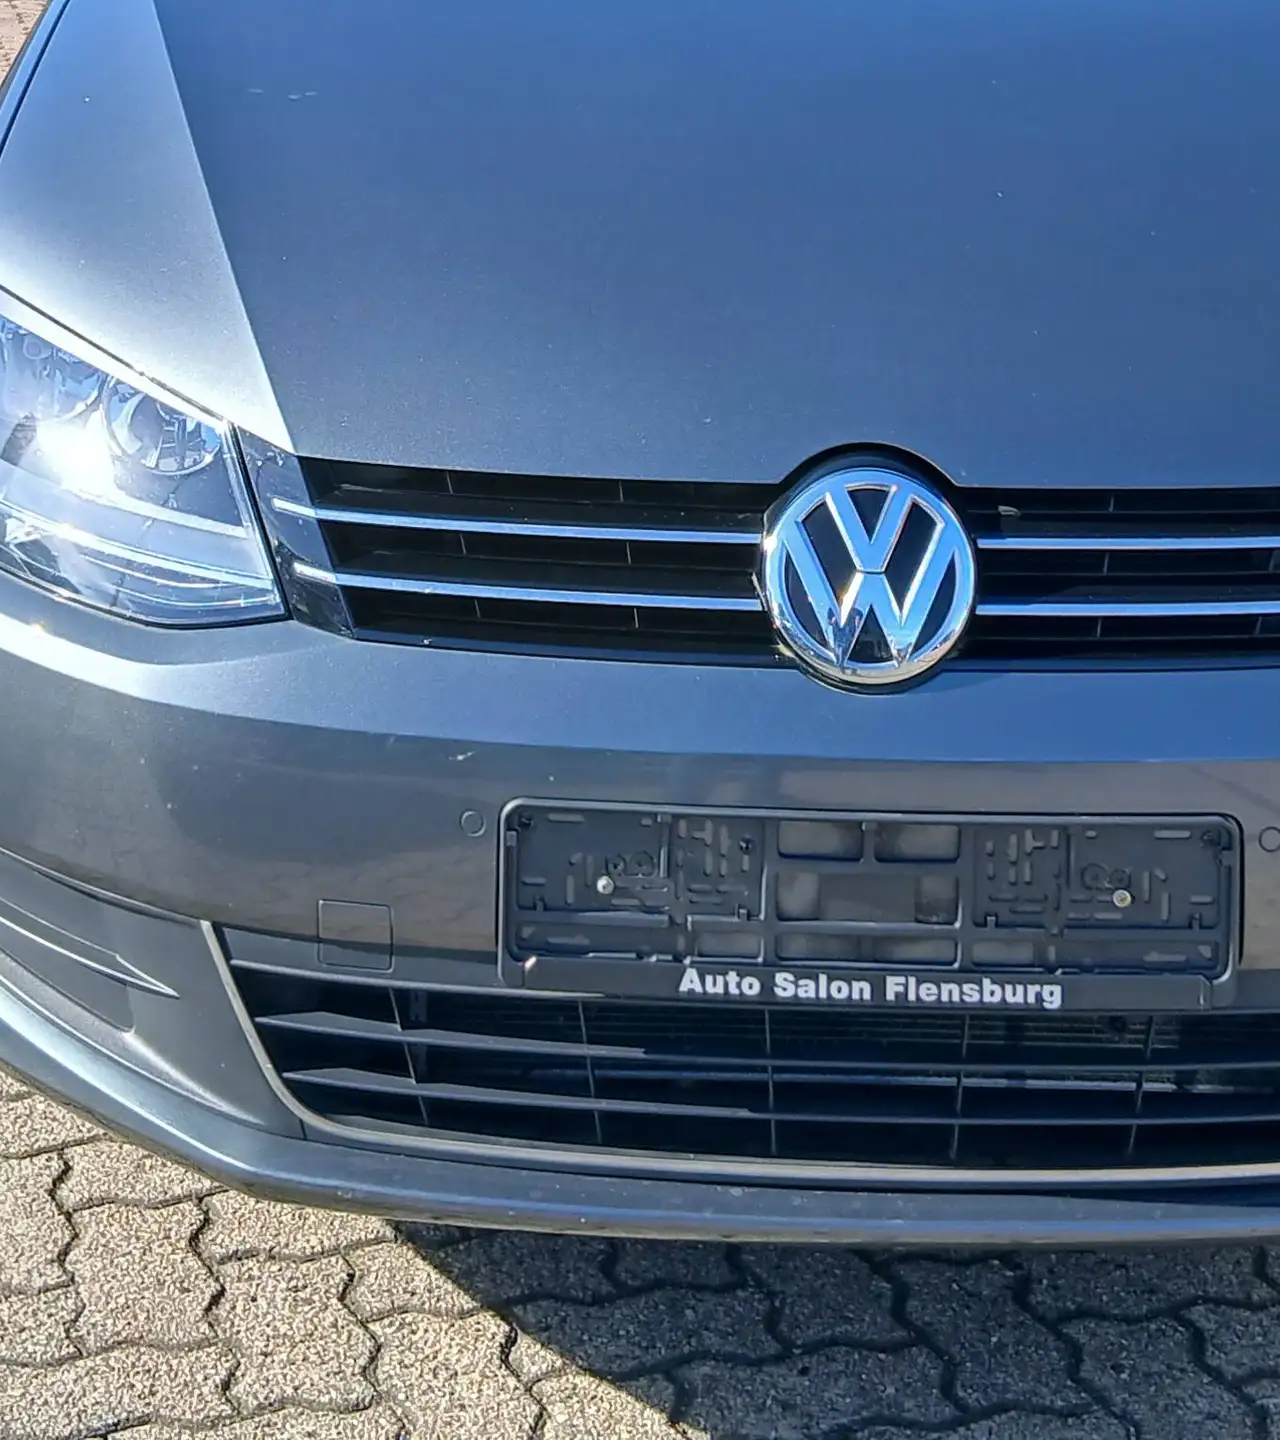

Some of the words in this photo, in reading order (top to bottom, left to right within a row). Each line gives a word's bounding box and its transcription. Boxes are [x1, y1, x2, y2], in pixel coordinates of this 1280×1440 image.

[679, 967, 761, 997] Auto
[773, 971, 872, 1001] Salon
[884, 974, 1063, 1010] Flensburg
